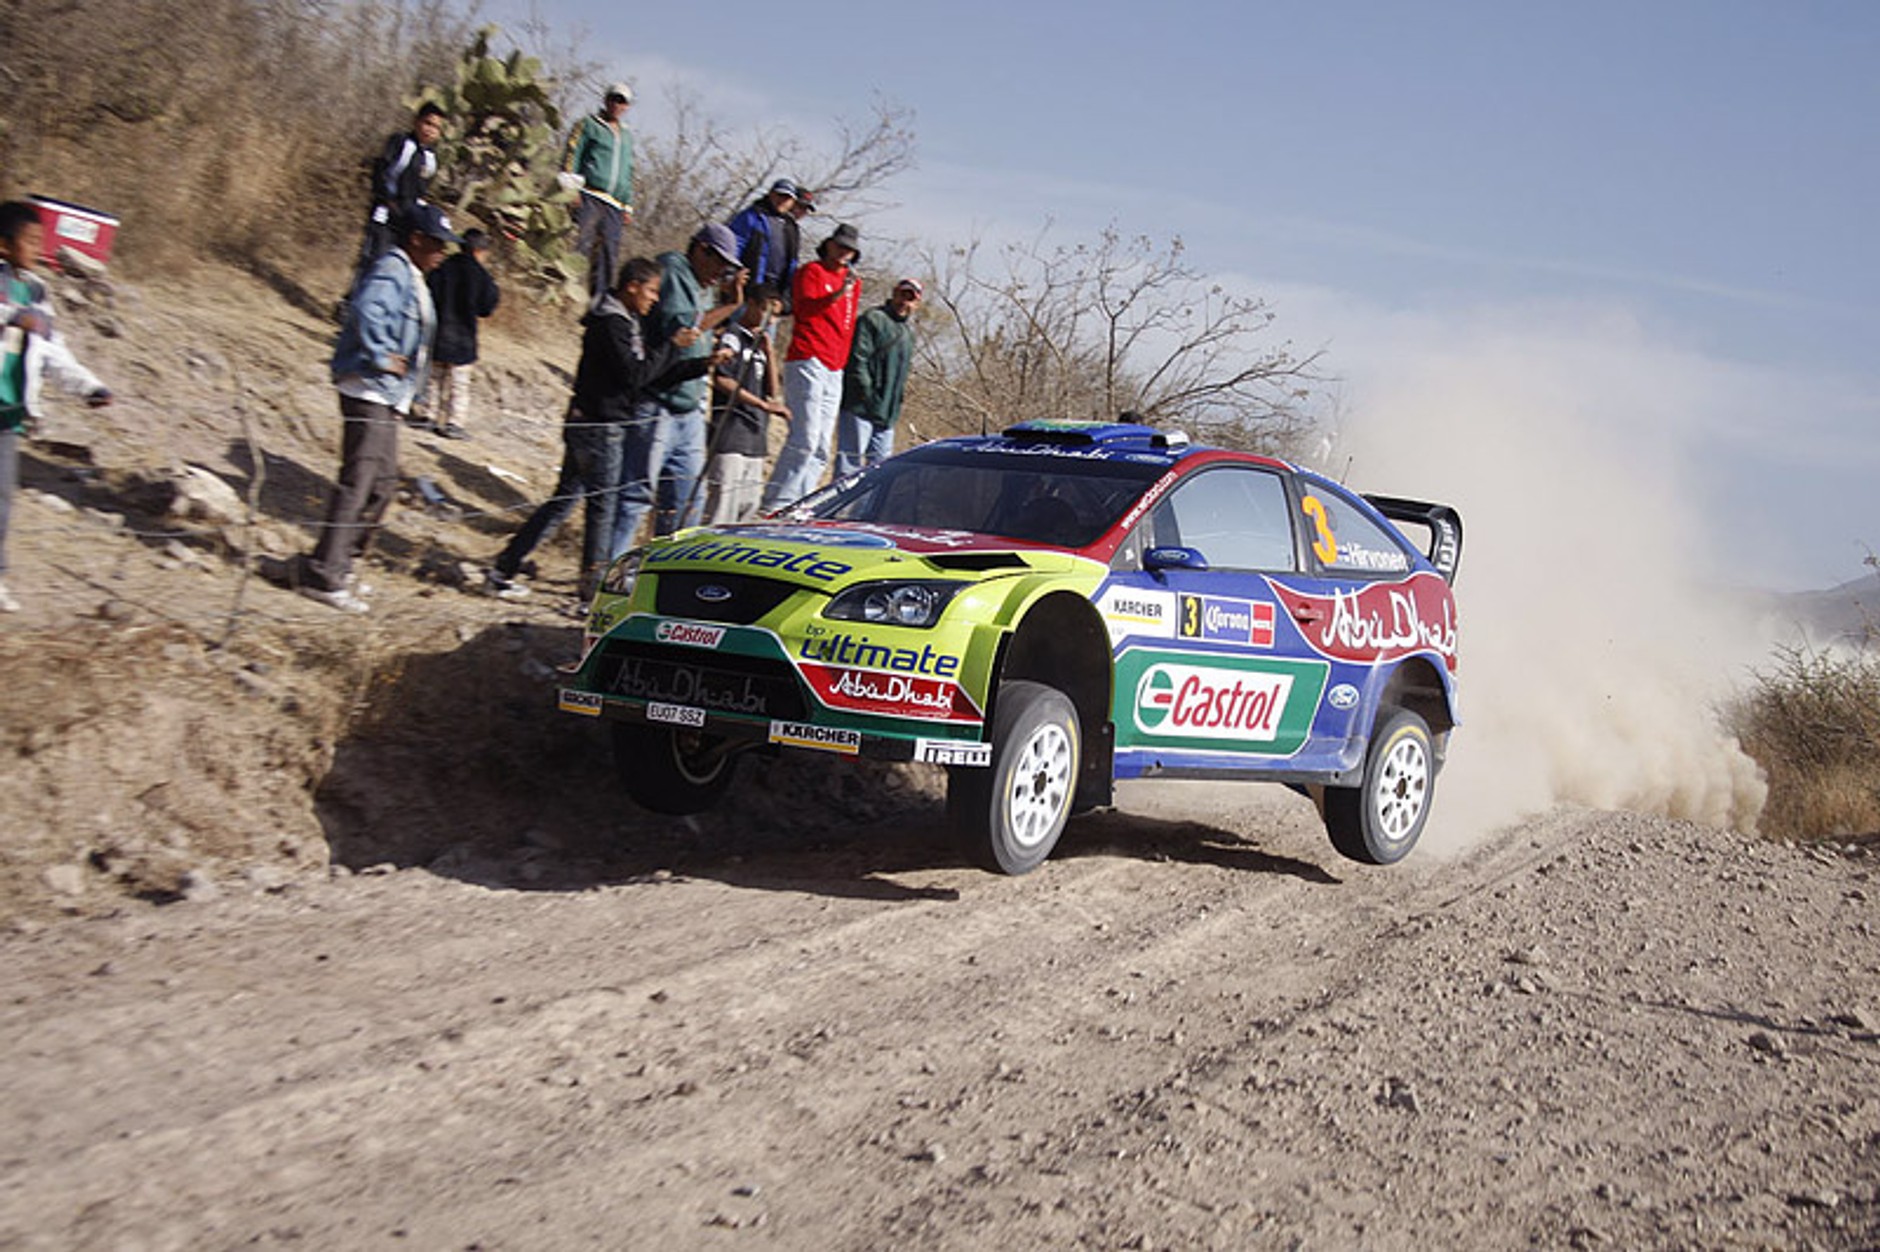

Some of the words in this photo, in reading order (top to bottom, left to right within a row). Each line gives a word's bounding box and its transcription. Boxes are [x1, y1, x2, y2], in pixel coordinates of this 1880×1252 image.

[1302, 495, 1338, 564] 3
[647, 541, 852, 582] ultimate
[670, 624, 722, 646] Castrol
[806, 623, 826, 637] bp
[1184, 596, 1198, 637] 3
[1205, 606, 1249, 634] Corona
[1388, 588, 1457, 657] Dhab
[800, 634, 959, 678] ultimate
[650, 704, 680, 720] EU07
[1172, 674, 1282, 730] Castrol
